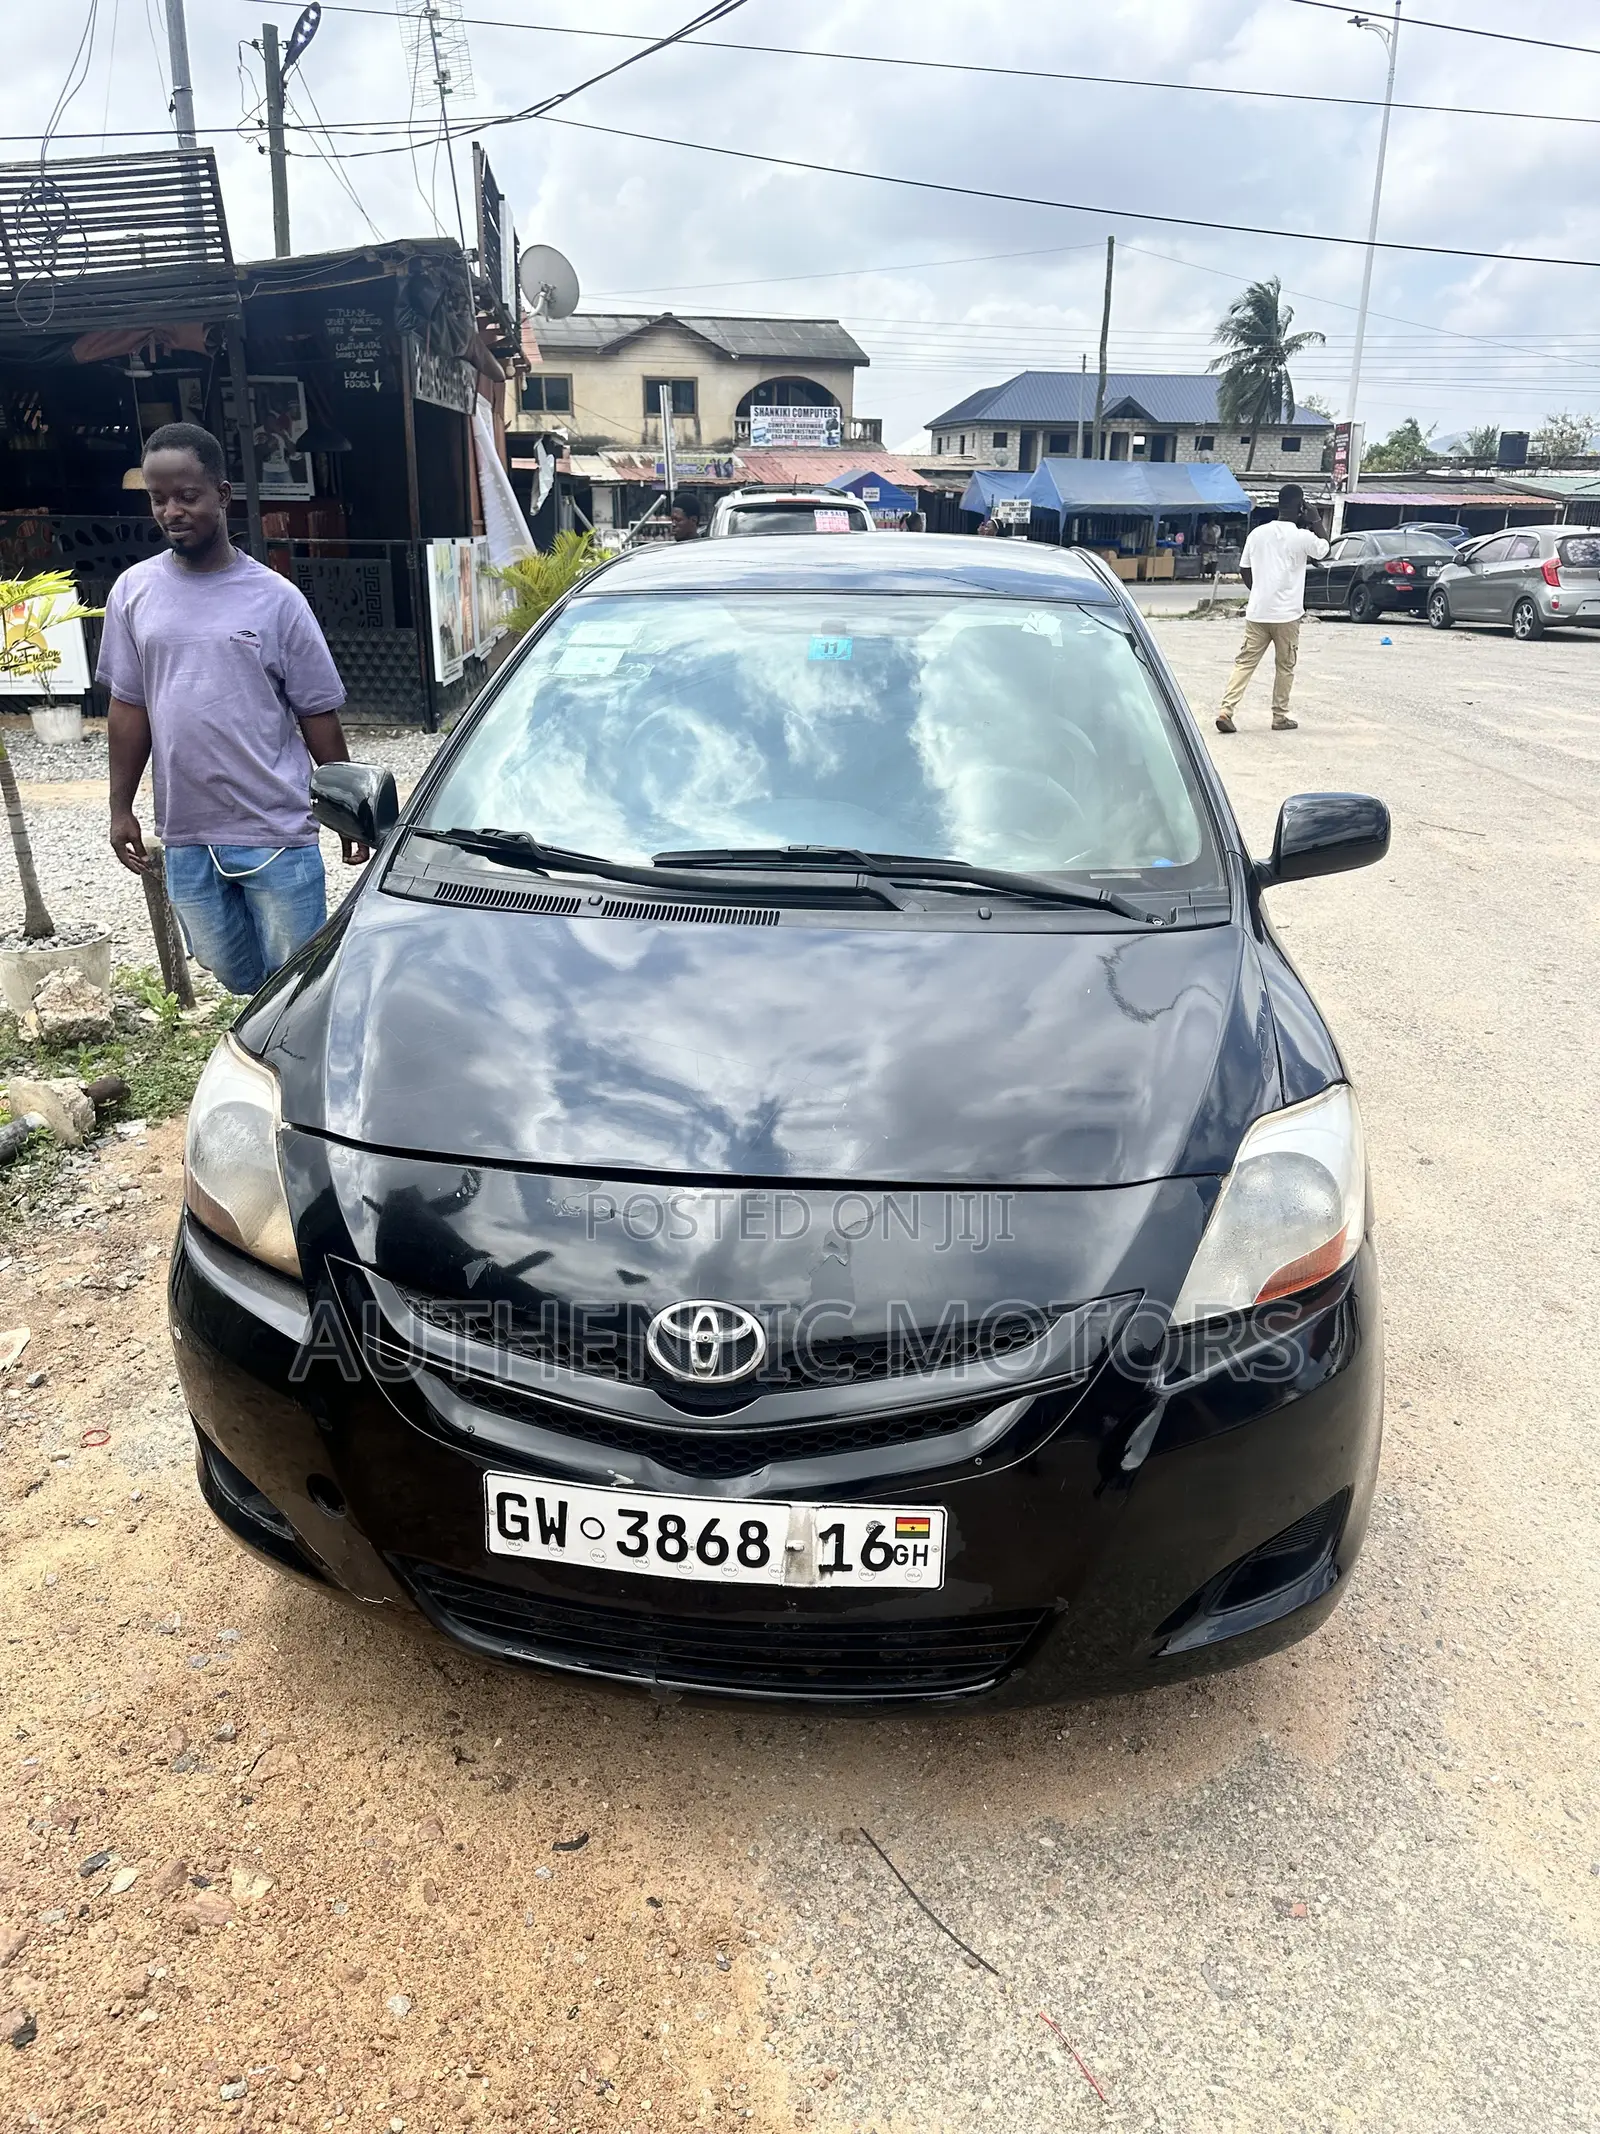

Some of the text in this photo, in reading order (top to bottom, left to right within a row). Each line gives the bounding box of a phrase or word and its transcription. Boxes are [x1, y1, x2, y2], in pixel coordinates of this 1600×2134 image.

[344, 371, 370, 379] LOCAL
[345, 380, 371, 389] FOODS
[754, 406, 838, 418] SHANKIKI COMPUTERS
[821, 642, 838, 653] 11
[496, 1491, 894, 1572] GW 3868 16
[893, 1544, 928, 1567] GH
